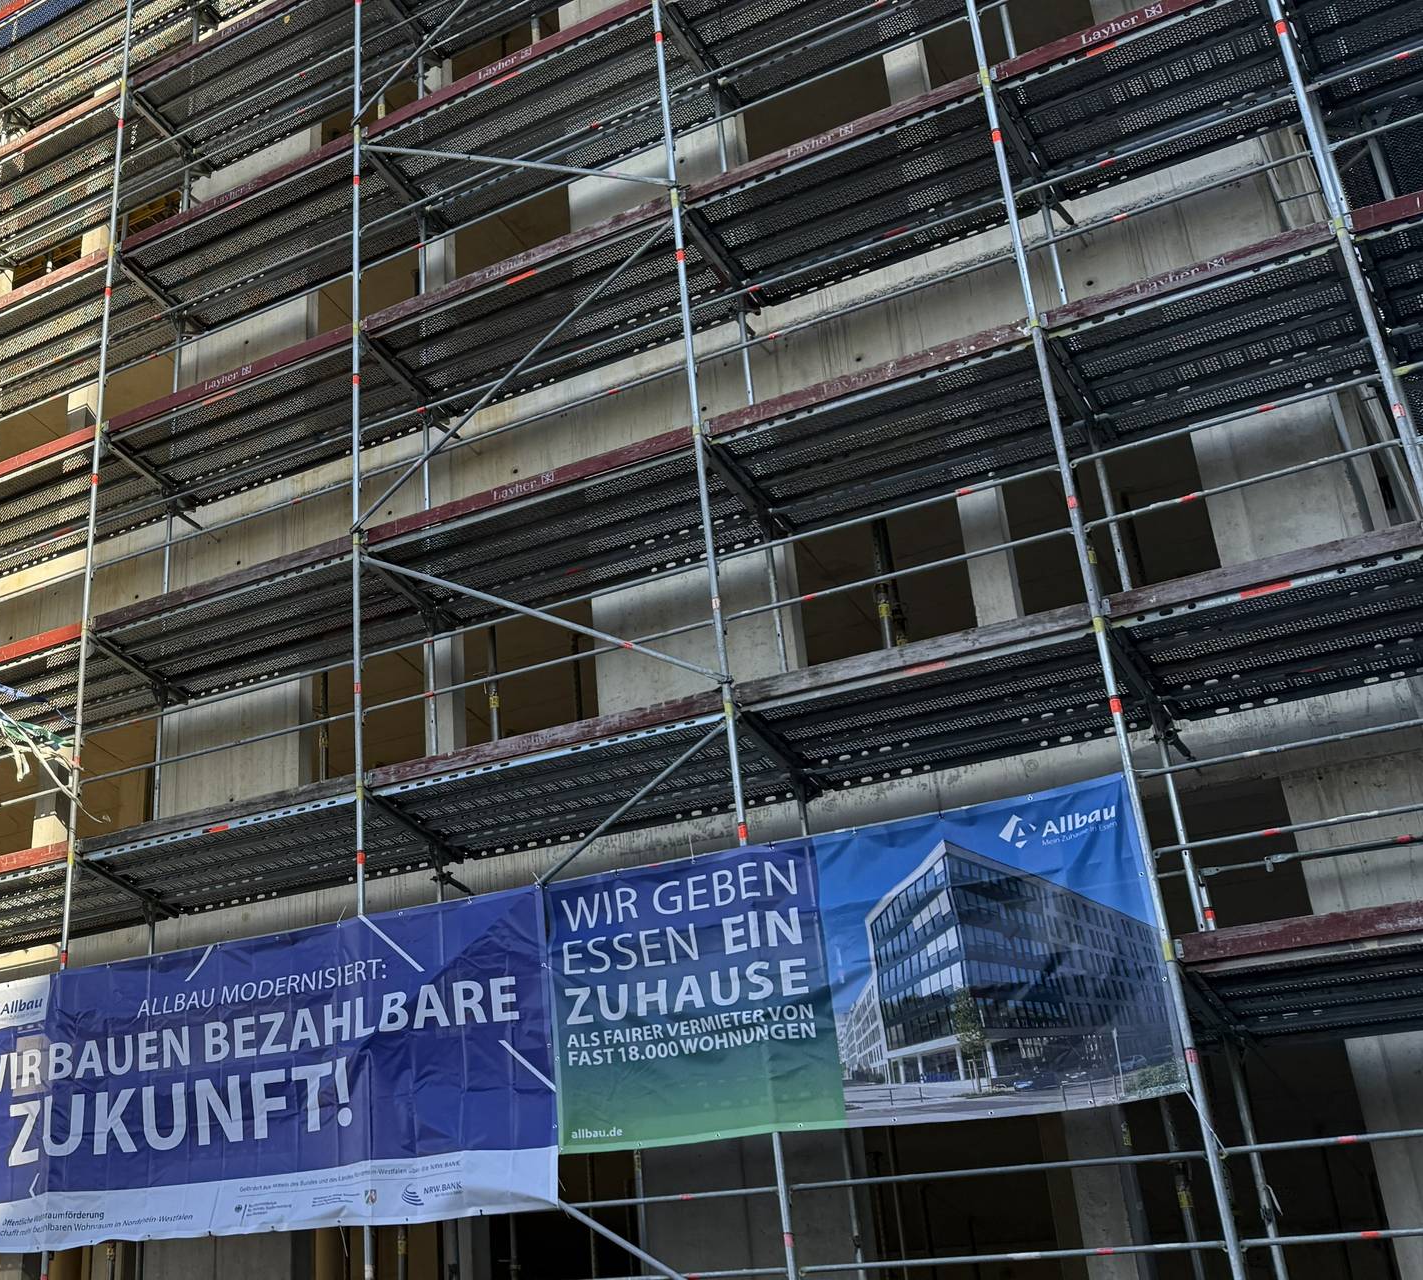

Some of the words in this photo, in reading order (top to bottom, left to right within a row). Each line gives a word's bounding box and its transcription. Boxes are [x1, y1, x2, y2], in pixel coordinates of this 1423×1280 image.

[1081, 13, 1140, 44] Layher
[478, 56, 517, 79] Layher
[786, 133, 835, 159] Layher
[204, 371, 240, 391] Layher
[493, 479, 538, 501] Layher
[1042, 804, 1117, 838] Allbau
[561, 887, 639, 932] WIR
[652, 859, 798, 915] GEBEN
[563, 923, 699, 975] ESSEN
[722, 907, 803, 955] EIN
[137, 988, 215, 1019] ALLBAU
[220, 958, 388, 1004] MODERNISIERT:
[564, 958, 809, 1025] ZUHAUSE
[0, 998, 44, 1016] Allbau
[48, 1025, 191, 1081] BAUEN
[204, 976, 520, 1064] BEZAHLBARE
[567, 1032, 601, 1049] ALS
[603, 1023, 664, 1045] FAIRER
[666, 1009, 766, 1037] VERMIETER
[765, 1004, 815, 1021] VON
[568, 1048, 615, 1067] FAST
[617, 1041, 679, 1063] 18.000
[679, 1022, 817, 1056] WOHNUNGEN
[8, 1056, 353, 1167] ZUKUNFT!
[571, 1126, 623, 1140] allbau.de
[423, 1180, 463, 1195] NRW.BANK
[33, 1210, 105, 1223] Wraumförderung
